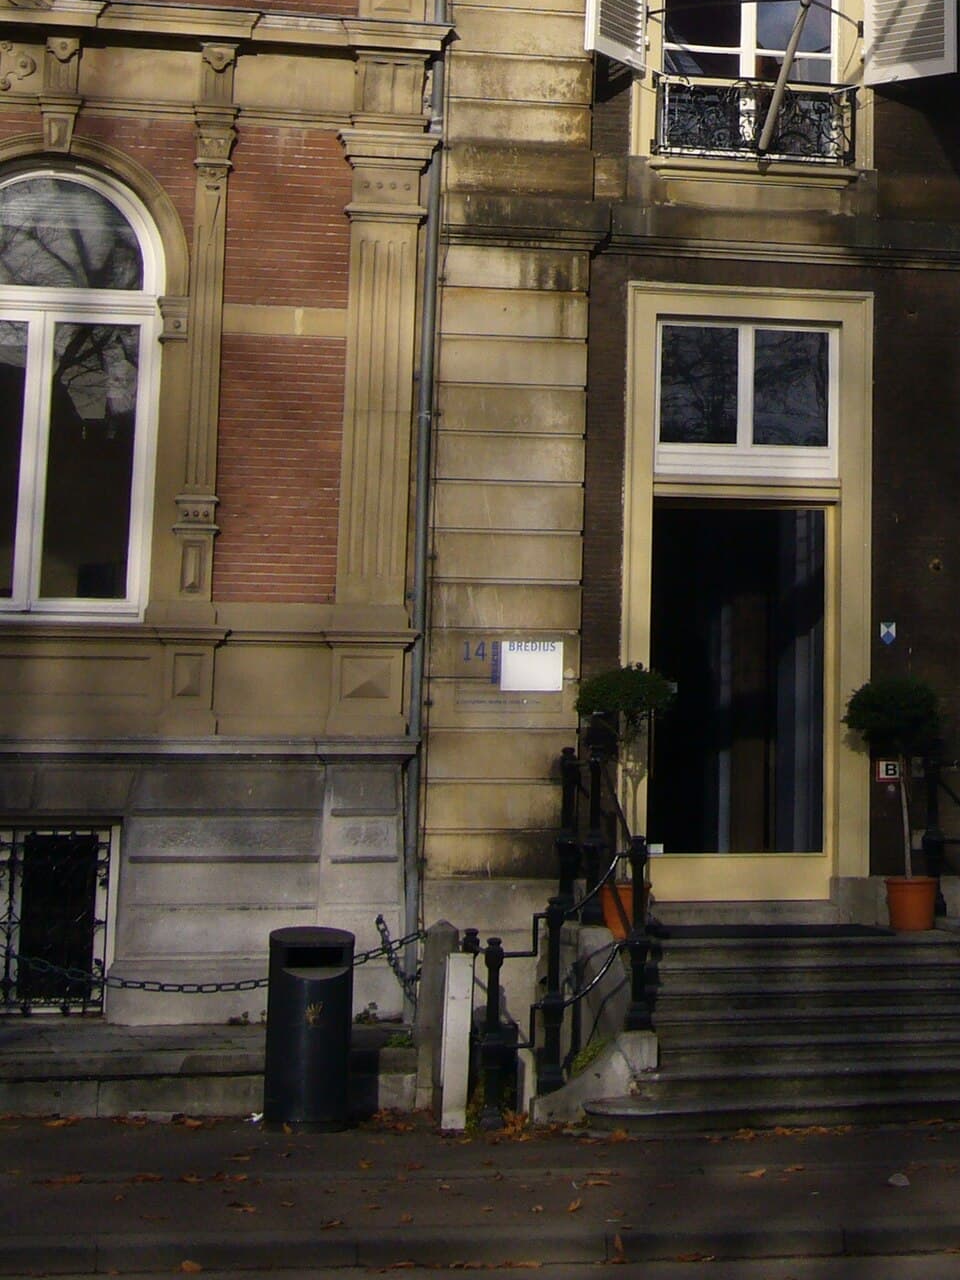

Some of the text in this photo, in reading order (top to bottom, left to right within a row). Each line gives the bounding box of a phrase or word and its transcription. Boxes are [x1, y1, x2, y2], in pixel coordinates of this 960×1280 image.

[464, 641, 486, 661] 14
[508, 641, 556, 652] BREDIUS
[885, 763, 897, 776] B
